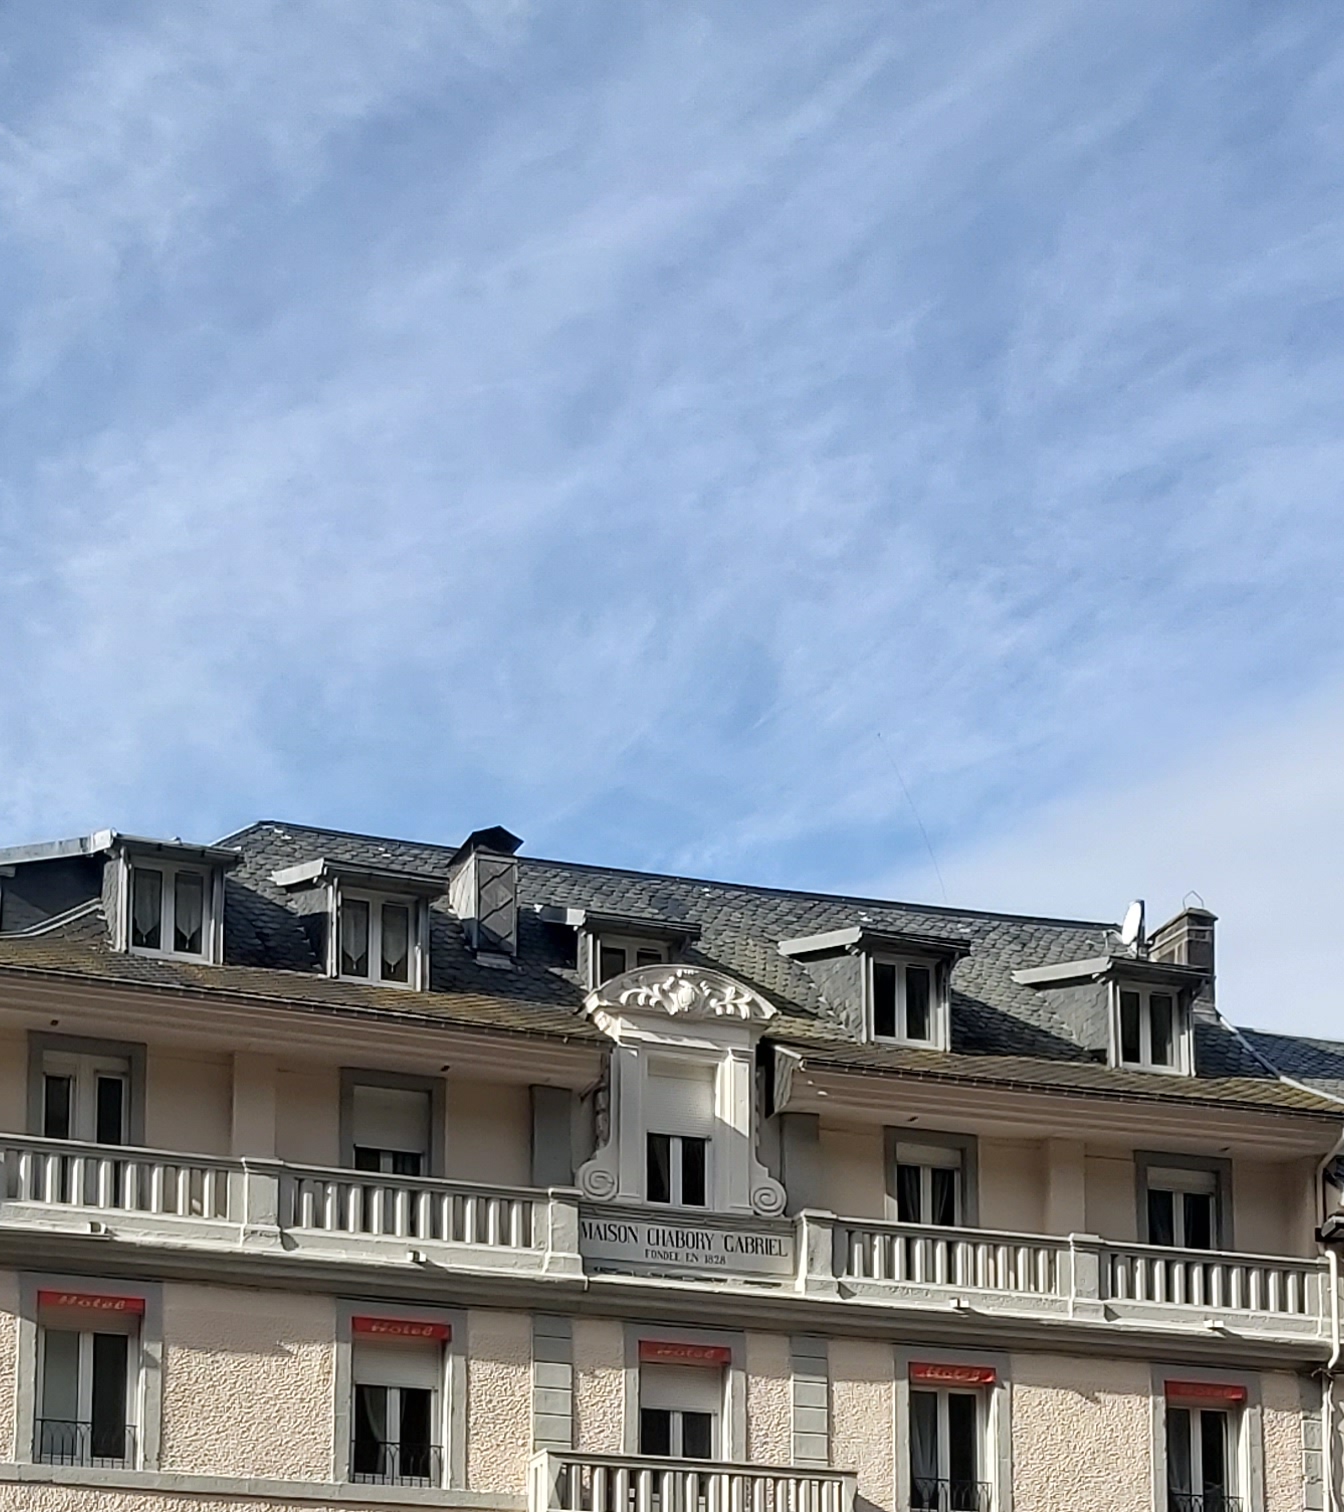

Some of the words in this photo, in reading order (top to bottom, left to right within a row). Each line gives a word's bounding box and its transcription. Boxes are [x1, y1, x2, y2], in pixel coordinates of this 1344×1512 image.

[581, 1220, 639, 1245] MAISON
[646, 1227, 715, 1251] CHABORY
[685, 1253, 699, 1263] EN
[704, 1255, 727, 1266] 1828
